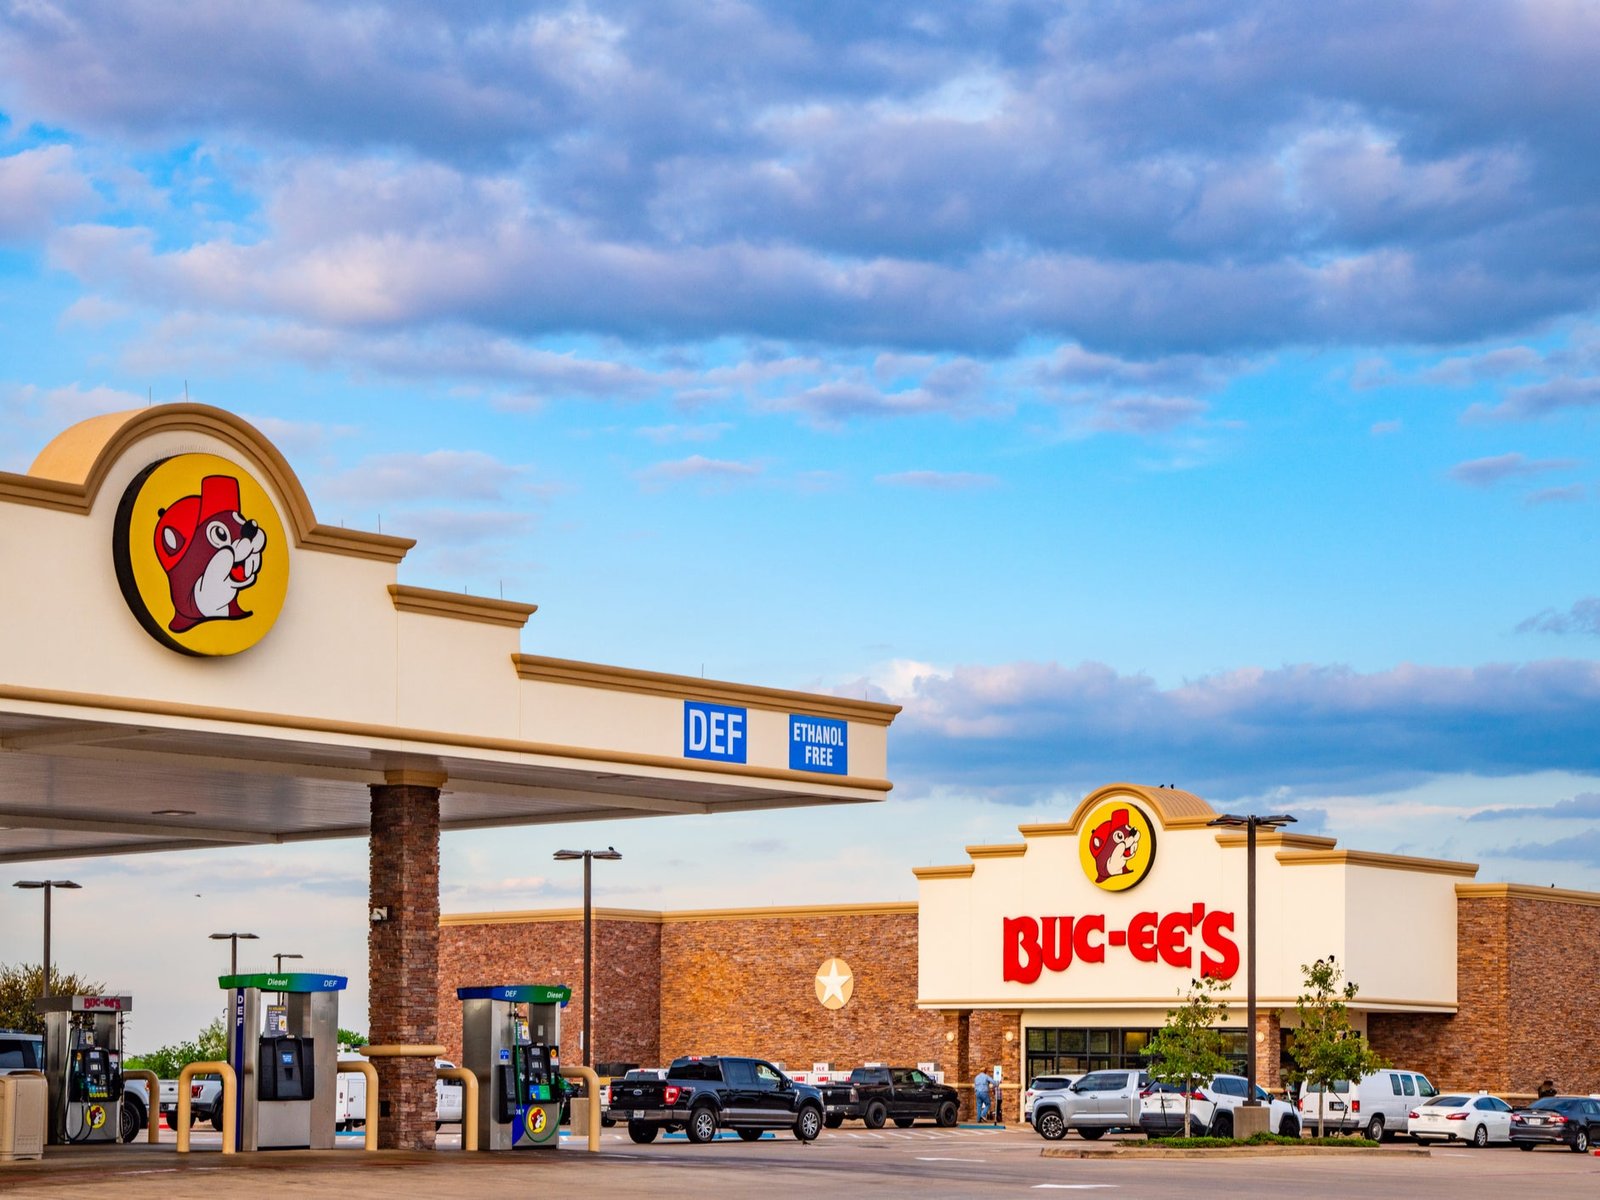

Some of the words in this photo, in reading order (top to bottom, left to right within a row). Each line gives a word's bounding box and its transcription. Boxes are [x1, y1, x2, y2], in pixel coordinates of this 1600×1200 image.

[689, 709, 742, 755] DEF
[793, 722, 844, 747] ETHANOL
[805, 746, 833, 767] FREE
[1003, 902, 1240, 985] BUC-EE'S
[267, 978, 288, 987] Diesel
[323, 980, 338, 988] DEF
[504, 990, 518, 998] DEF
[547, 991, 564, 999] Diesel
